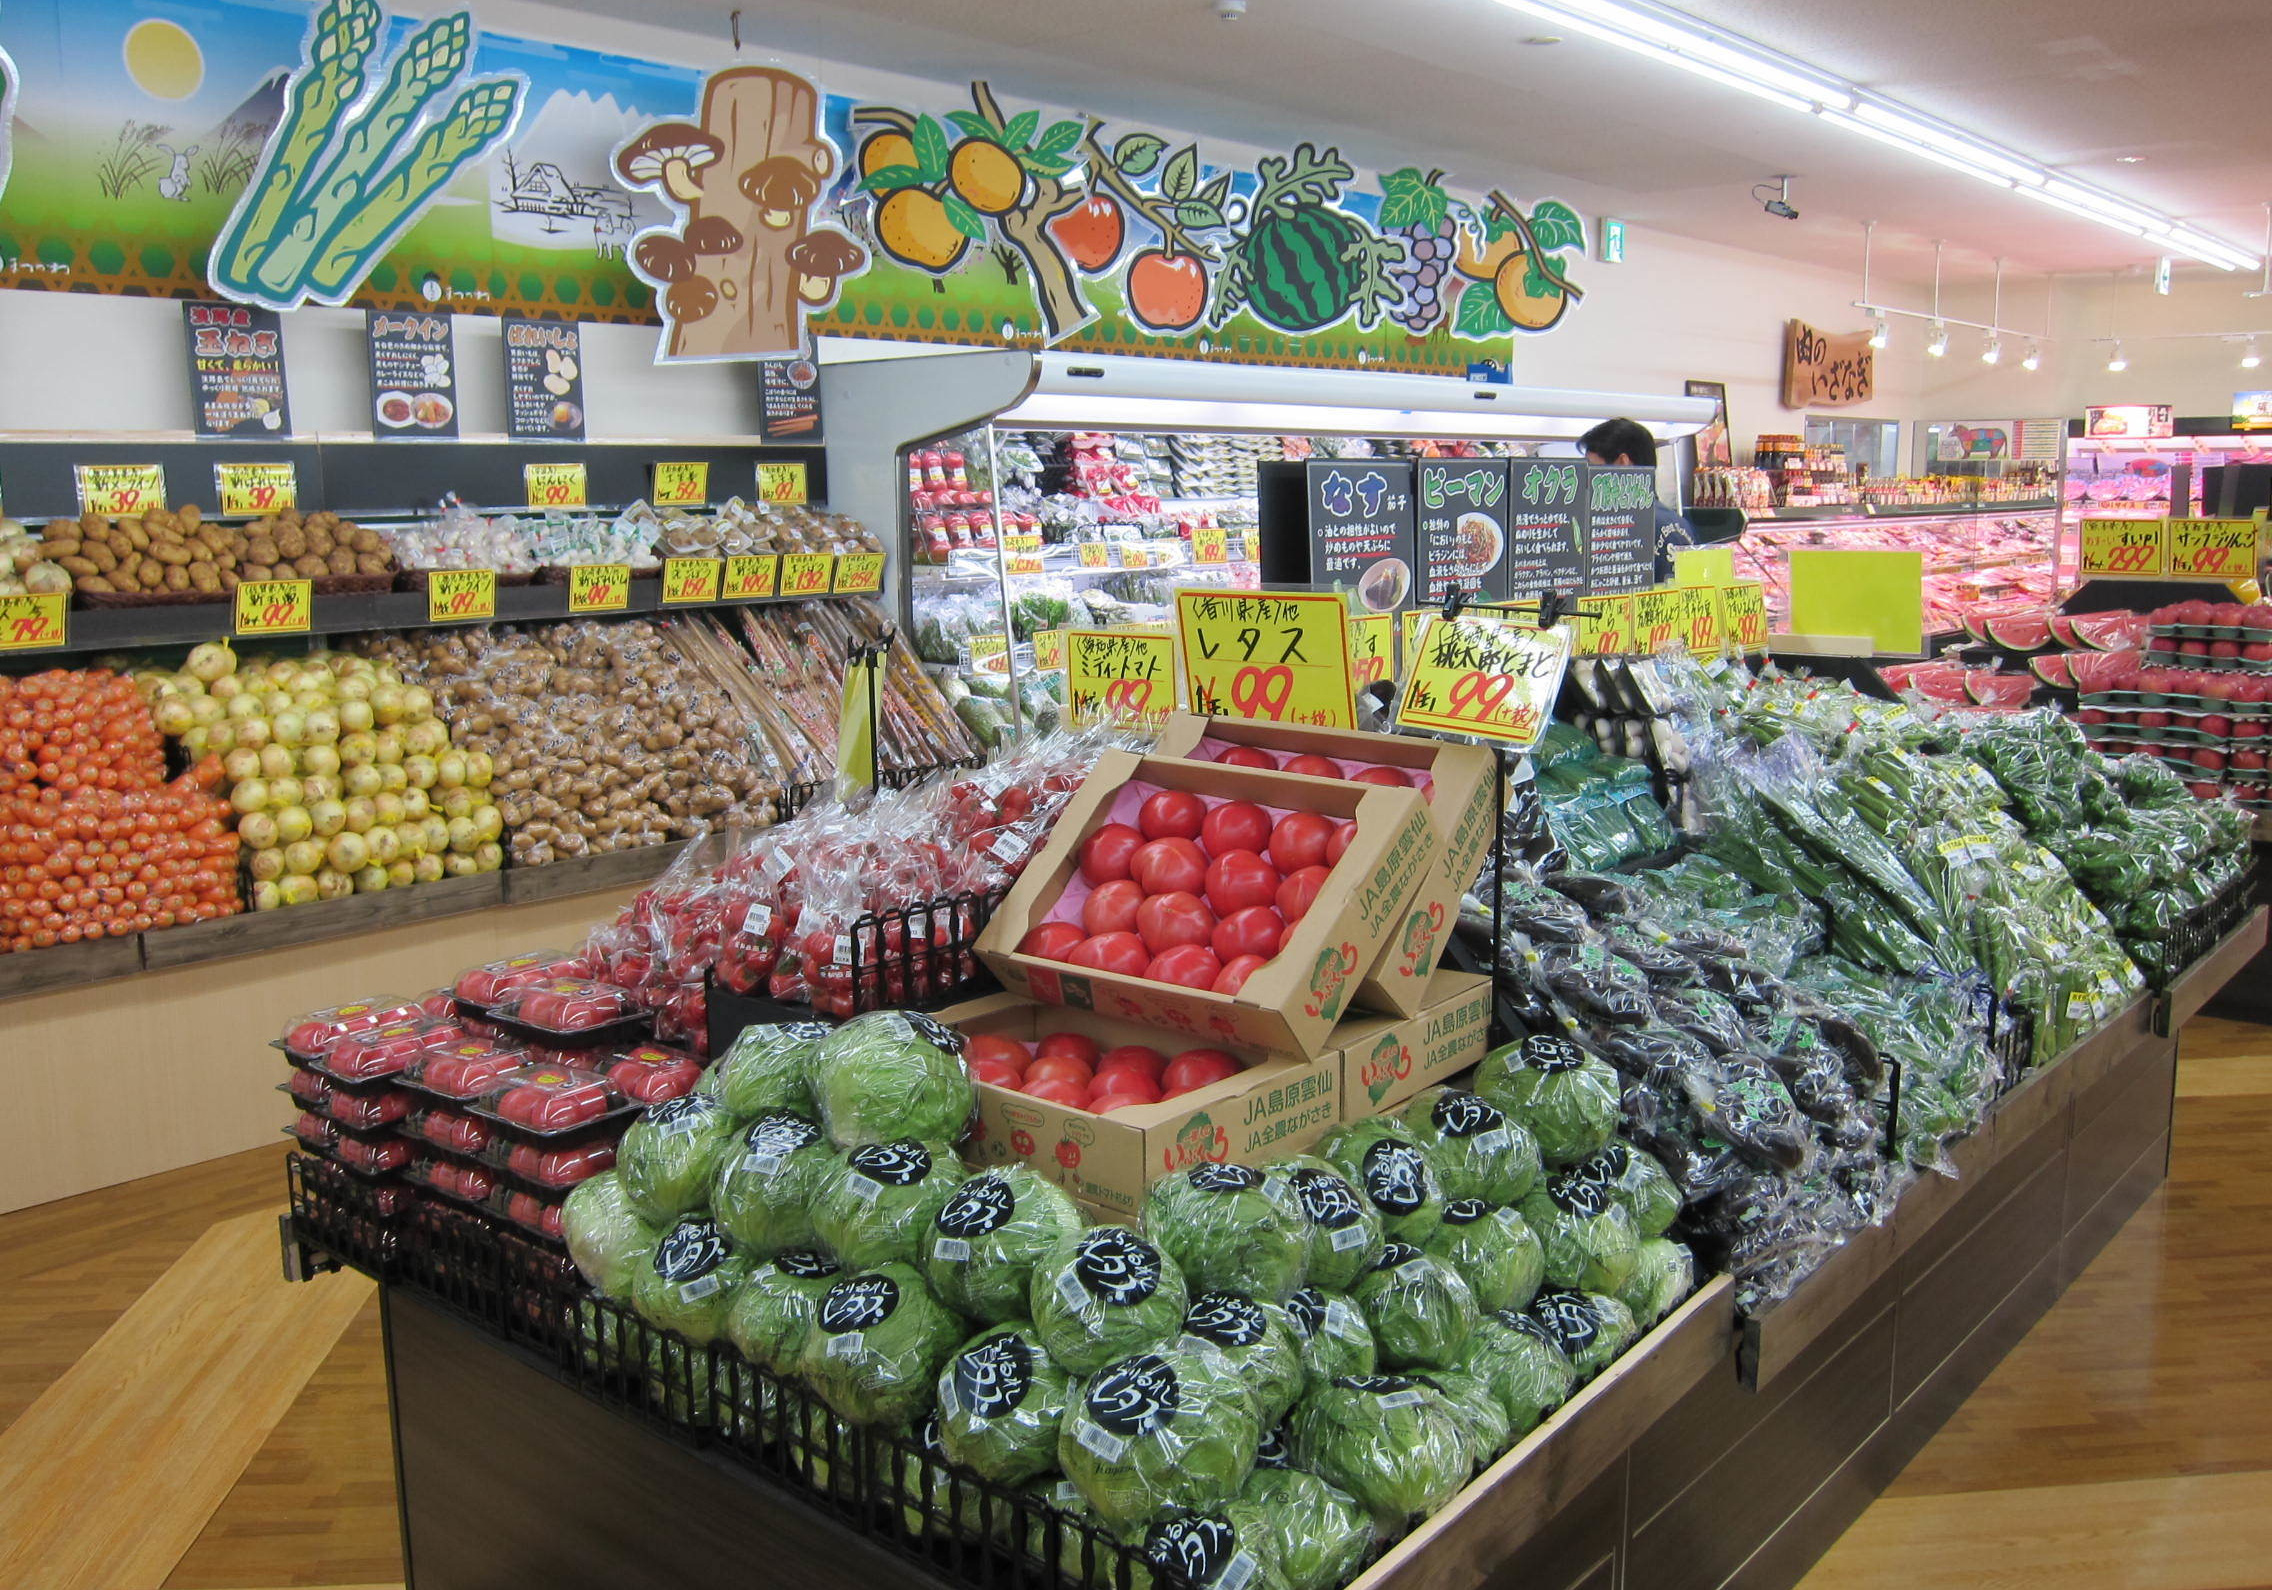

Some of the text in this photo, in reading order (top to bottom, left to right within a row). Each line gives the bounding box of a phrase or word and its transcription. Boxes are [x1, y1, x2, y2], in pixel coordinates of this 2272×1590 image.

[373, 315, 448, 341] メークイン
[508, 324, 578, 350] ばれいしょ
[537, 473, 577, 485] にんにく
[675, 481, 698, 500] 59
[775, 482, 794, 501] 99
[1423, 467, 1505, 508] ピーマン
[1522, 464, 1579, 505] オクラ
[110, 490, 141, 513] 39
[249, 487, 277, 509] 39
[545, 485, 571, 504] 99
[1321, 469, 1388, 518] なす
[1324, 522, 1397, 538] 油との相性がよいので
[1324, 539, 1392, 555] 炒めものや天ぷらに
[2108, 545, 2156, 571] 299
[2192, 546, 2230, 573] 99
[451, 592, 476, 614] 99
[588, 585, 611, 605] 99
[262, 604, 295, 626] 99
[10, 616, 50, 641] 79
[1197, 627, 1308, 664] レタス
[1081, 654, 1162, 681] ミディートマト
[1430, 639, 1554, 679] 桃太郎とまと
[1231, 665, 1294, 721] 99
[1448, 670, 1516, 723] 99
[1358, 810, 1428, 921] JA島原雲仙
[1370, 830, 1435, 939] JA全農ながさき
[1423, 994, 1492, 1046] JA島原雲仙
[1243, 1069, 1332, 1125] JA島原雲仙
[1244, 1101, 1332, 1153] JA全農ながさき
